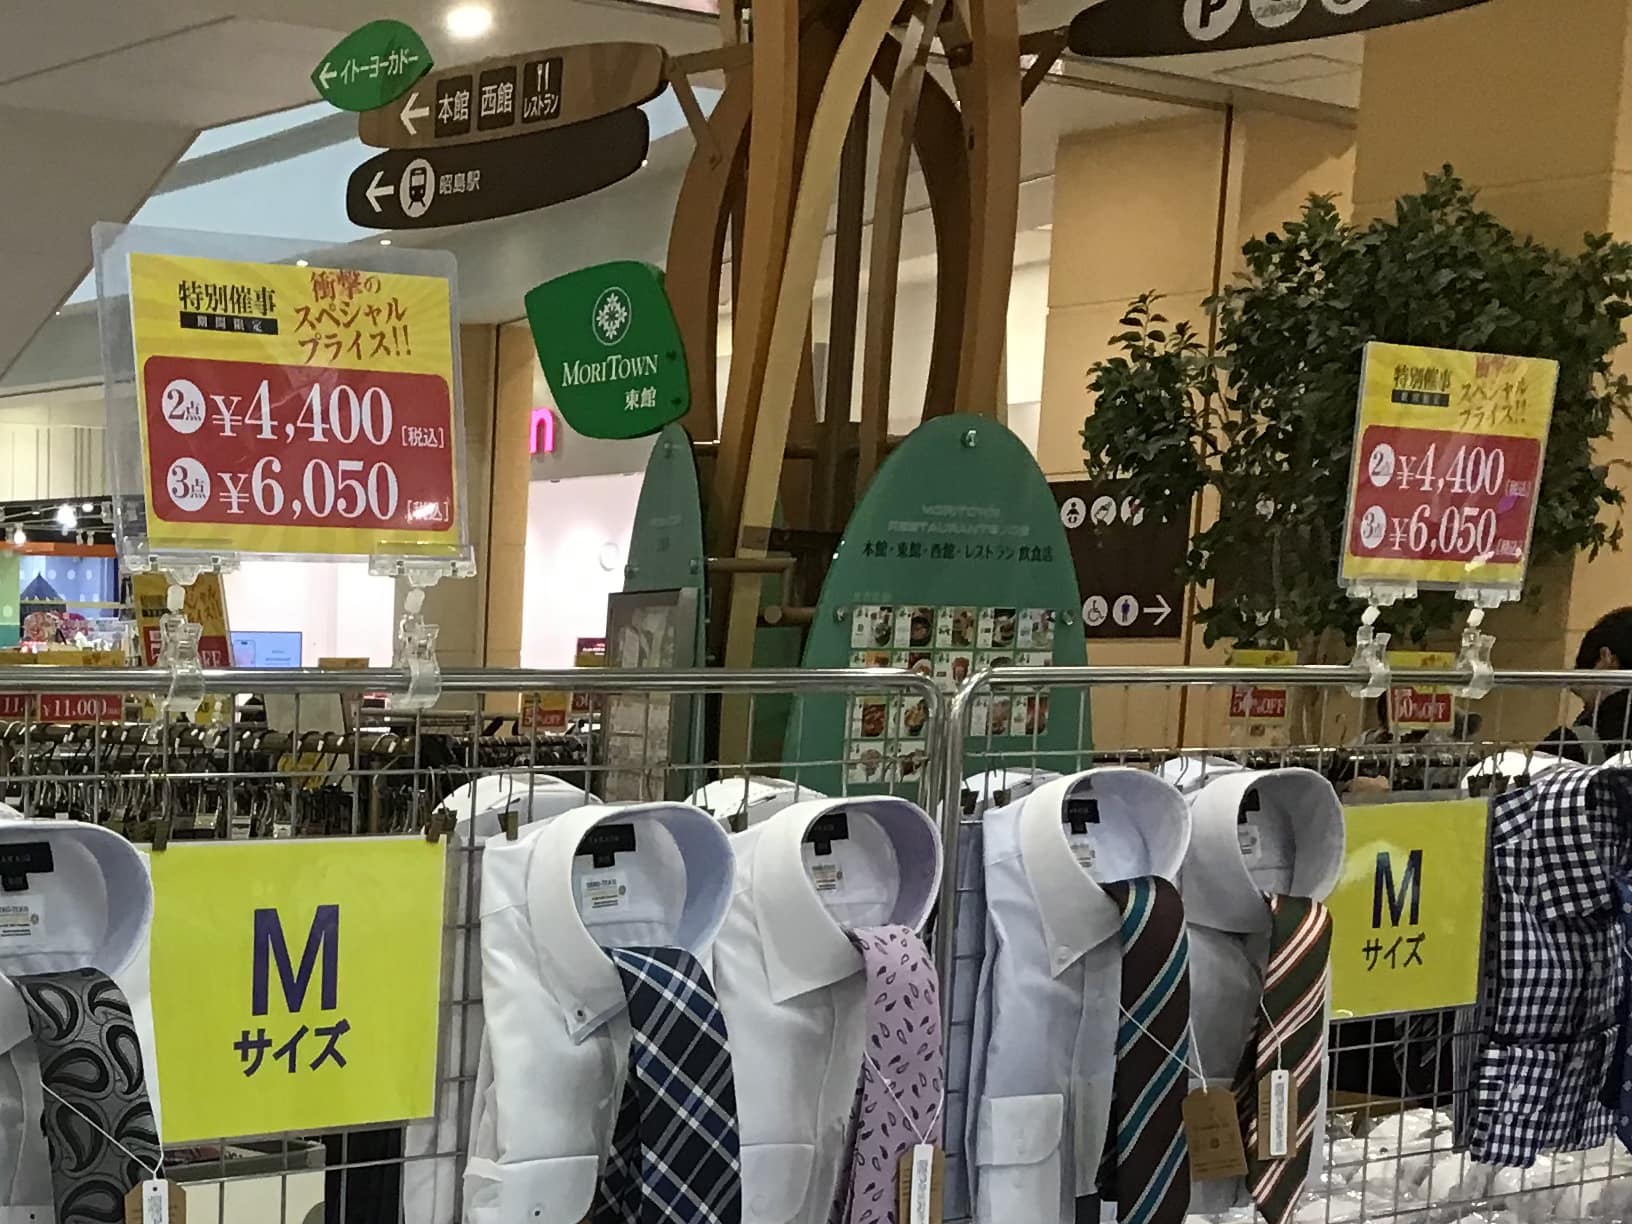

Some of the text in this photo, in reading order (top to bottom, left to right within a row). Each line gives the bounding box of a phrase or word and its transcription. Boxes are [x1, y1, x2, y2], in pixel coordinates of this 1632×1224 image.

[340, 49, 419, 85] イトーヨーカドー
[438, 82, 514, 124] 本館 西館
[523, 93, 559, 119] レストラン
[439, 170, 480, 196] 昭島駅
[178, 280, 276, 316] 特別催事
[310, 269, 381, 303] 衝撃の
[295, 297, 408, 332] スペシャル
[298, 325, 411, 364] プライス!!
[167, 379, 445, 449] 2点 ¥4,400 [税込]
[624, 386, 657, 411] 東館
[171, 465, 207, 499] 3点
[217, 456, 399, 521] ¥6,050
[1397, 442, 1504, 495] ¥4,400
[1390, 504, 1496, 553] ¥6,050
[1372, 849, 1423, 928] M
[252, 904, 339, 1016] M
[1362, 932, 1426, 972] サイズ
[233, 1019, 351, 1078] サイズ
